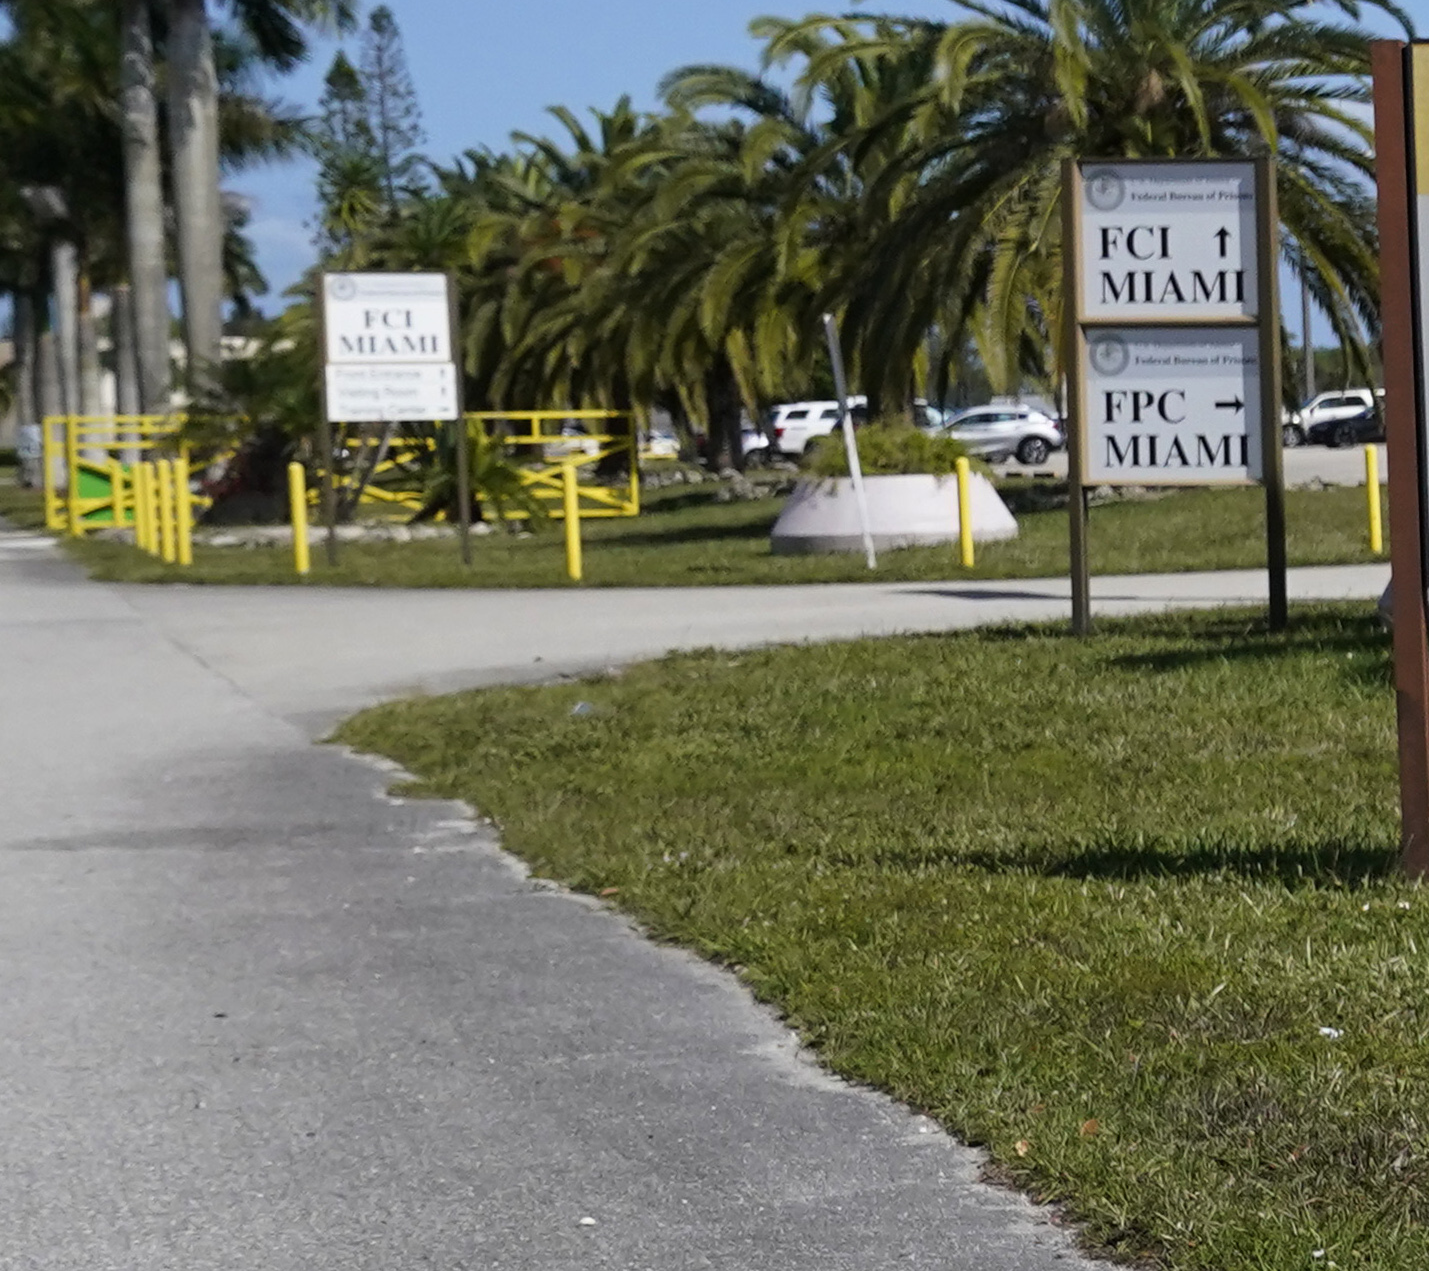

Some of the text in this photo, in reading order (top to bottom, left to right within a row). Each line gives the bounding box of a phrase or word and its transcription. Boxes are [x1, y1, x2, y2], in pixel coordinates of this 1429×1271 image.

[1099, 226, 1173, 261] FCI
[1101, 269, 1249, 305] MIAMI
[364, 309, 413, 329] FCI
[339, 335, 440, 356] MIAMI
[1103, 388, 1187, 425] FPC
[1104, 433, 1251, 468] MIAMI
